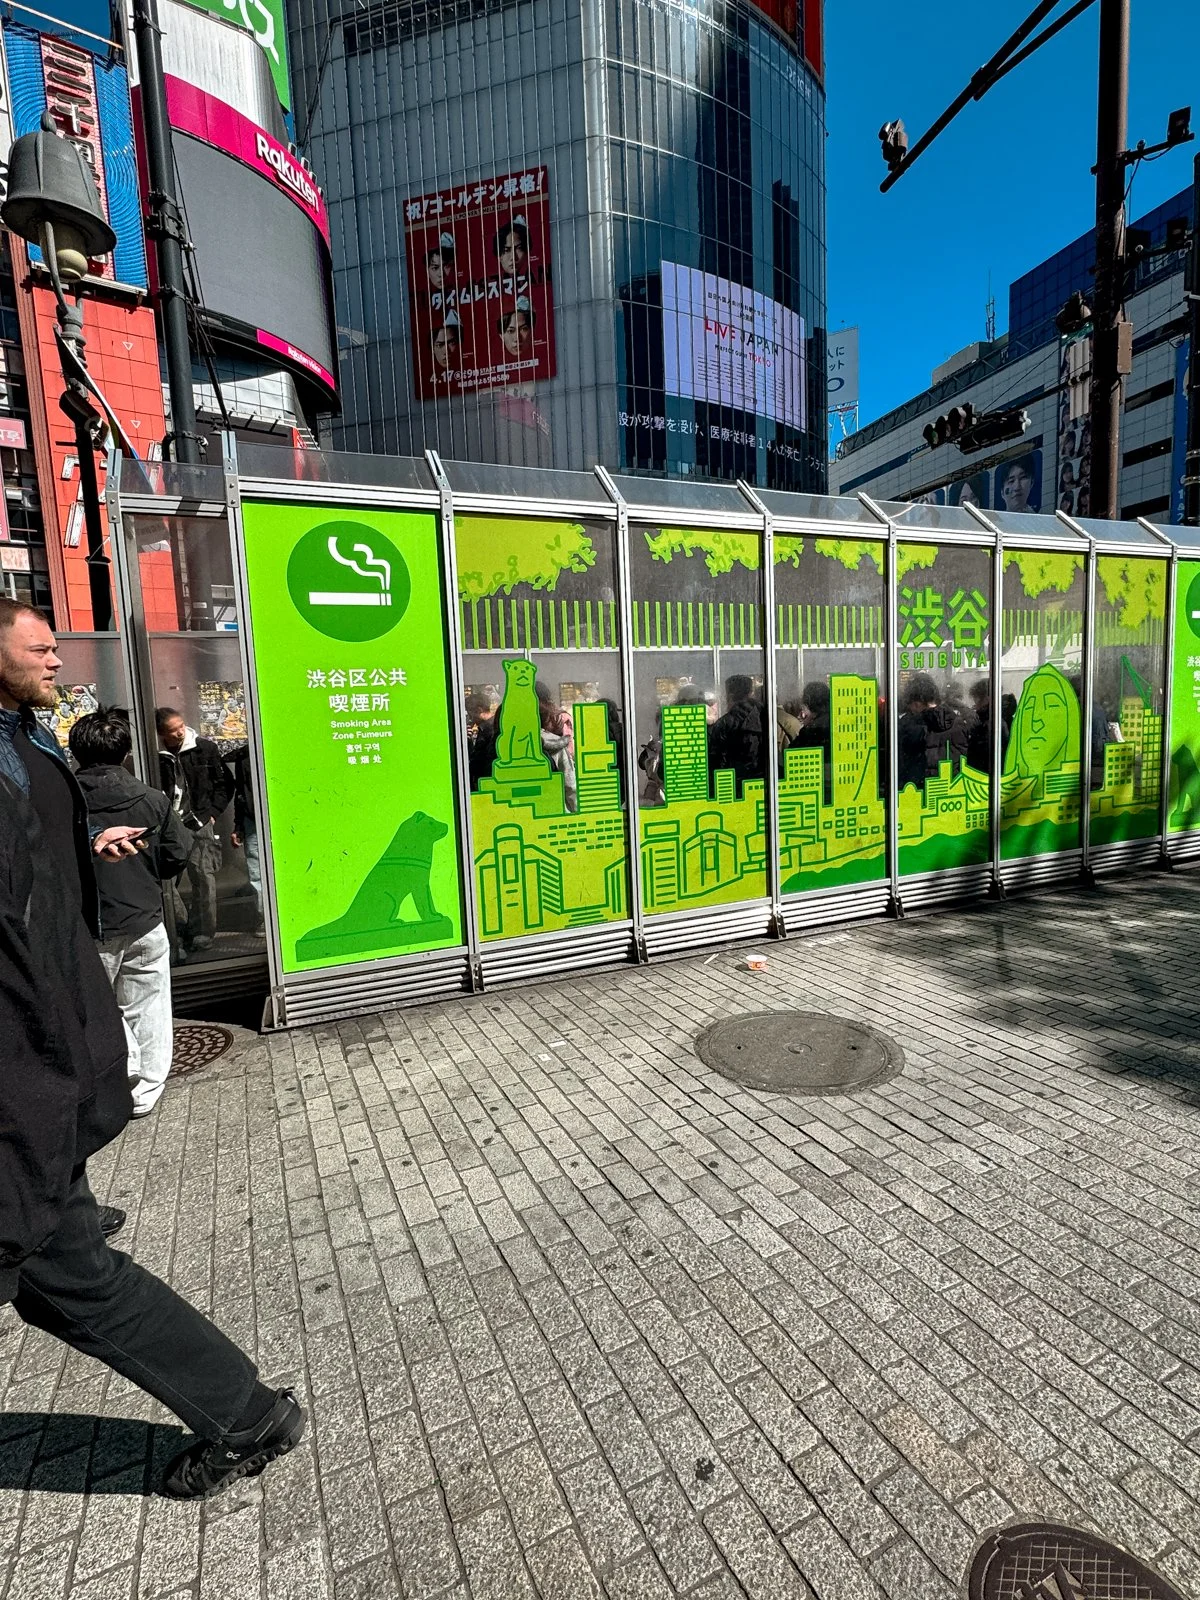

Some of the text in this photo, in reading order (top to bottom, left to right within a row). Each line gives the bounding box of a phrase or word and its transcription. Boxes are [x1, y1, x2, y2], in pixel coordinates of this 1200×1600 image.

[256, 133, 320, 212] Rakuten
[431, 276, 528, 310] タイムレスマン
[704, 316, 736, 340] LIVE
[741, 330, 779, 356] JAPAN
[748, 352, 771, 367] TOKYO
[899, 586, 988, 648] 渋谷
[901, 651, 988, 669] SHIBUYA
[306, 667, 408, 688] 渋谷区公共
[328, 693, 391, 713] 喫煙所
[330, 718, 392, 729] Smoking Area
[332, 730, 393, 740] Zone Fumeurs
